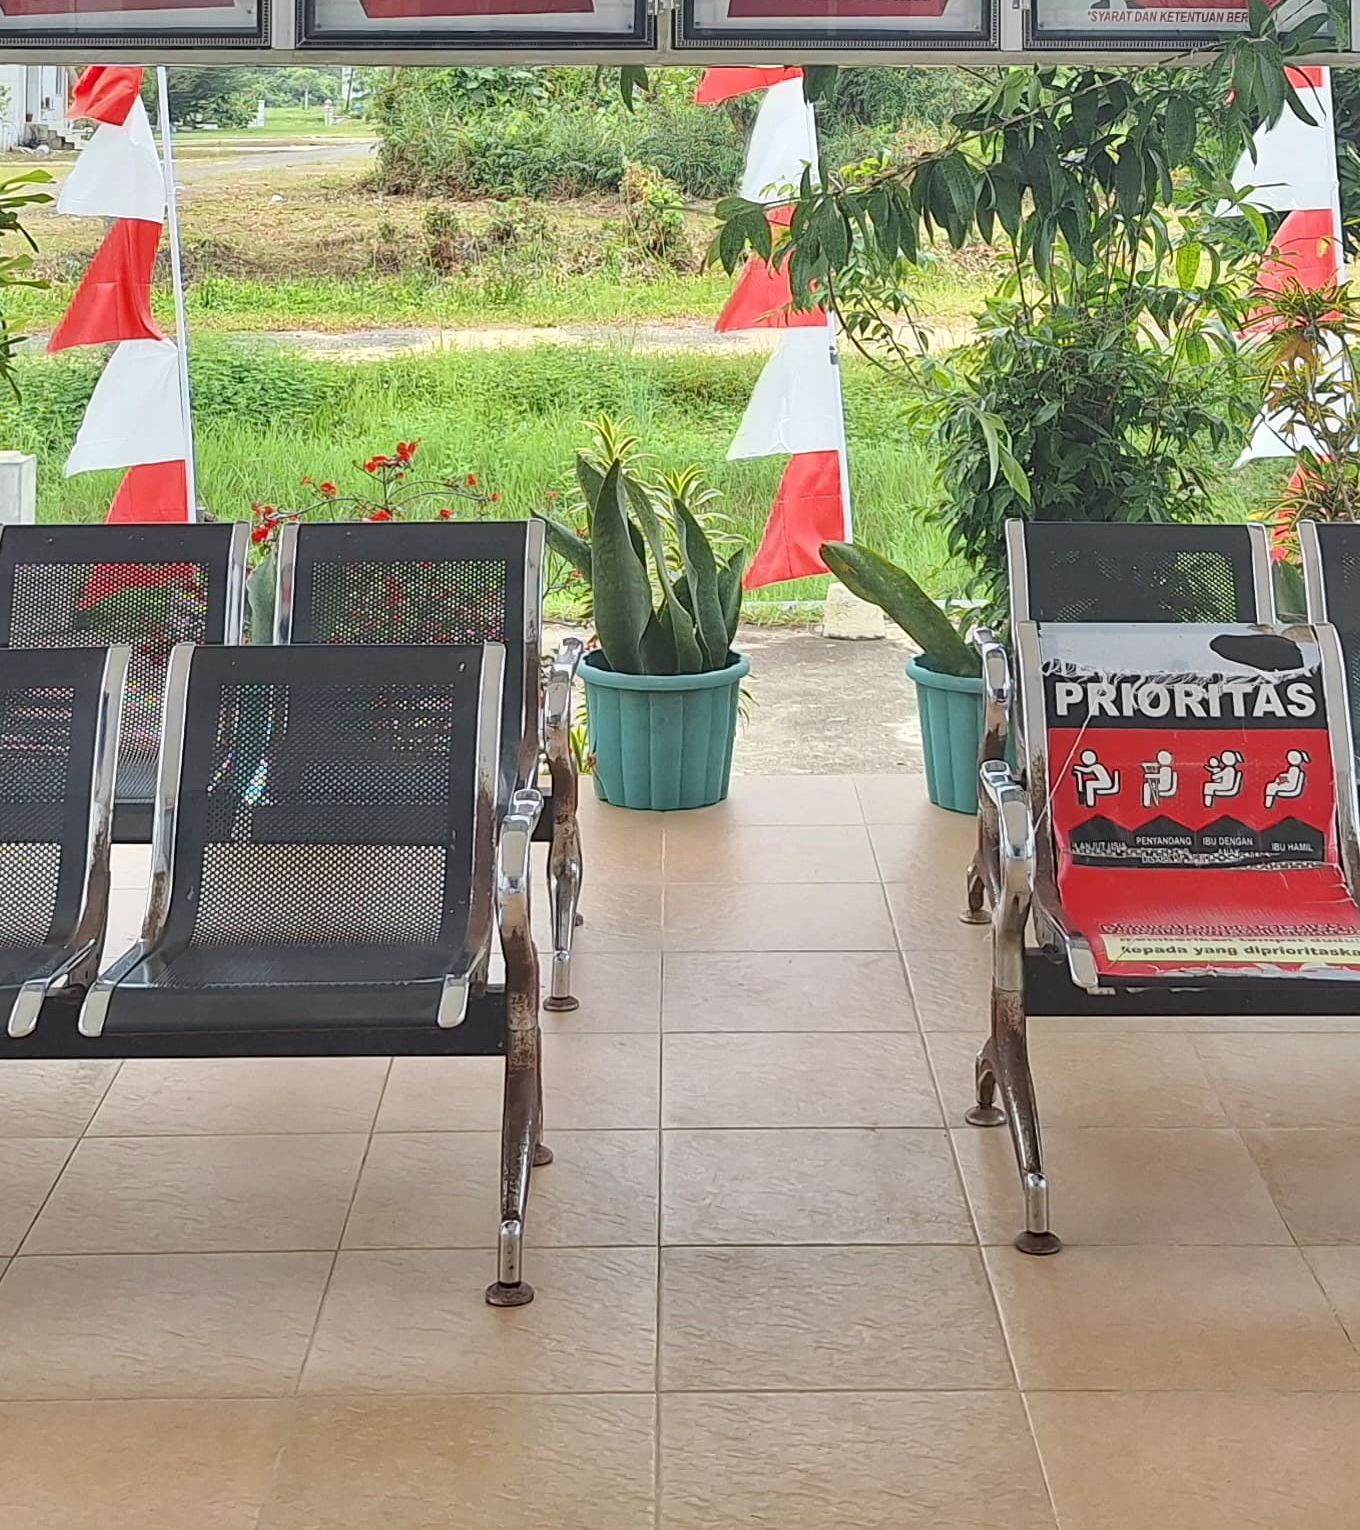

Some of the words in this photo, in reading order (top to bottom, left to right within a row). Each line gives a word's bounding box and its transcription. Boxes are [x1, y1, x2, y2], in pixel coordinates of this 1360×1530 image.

[1135, 11, 1158, 22] DAN
[1160, 11, 1224, 23] KETENTUAN
[1055, 681, 1317, 719] PRIORITAS
[1136, 836, 1192, 846] PENYANDANG
[1202, 837, 1216, 846] IBU
[1218, 837, 1253, 846] DENGAN
[1271, 843, 1288, 852] IBU
[1290, 844, 1314, 852] HAMIL
[1193, 947, 1238, 957] yang
